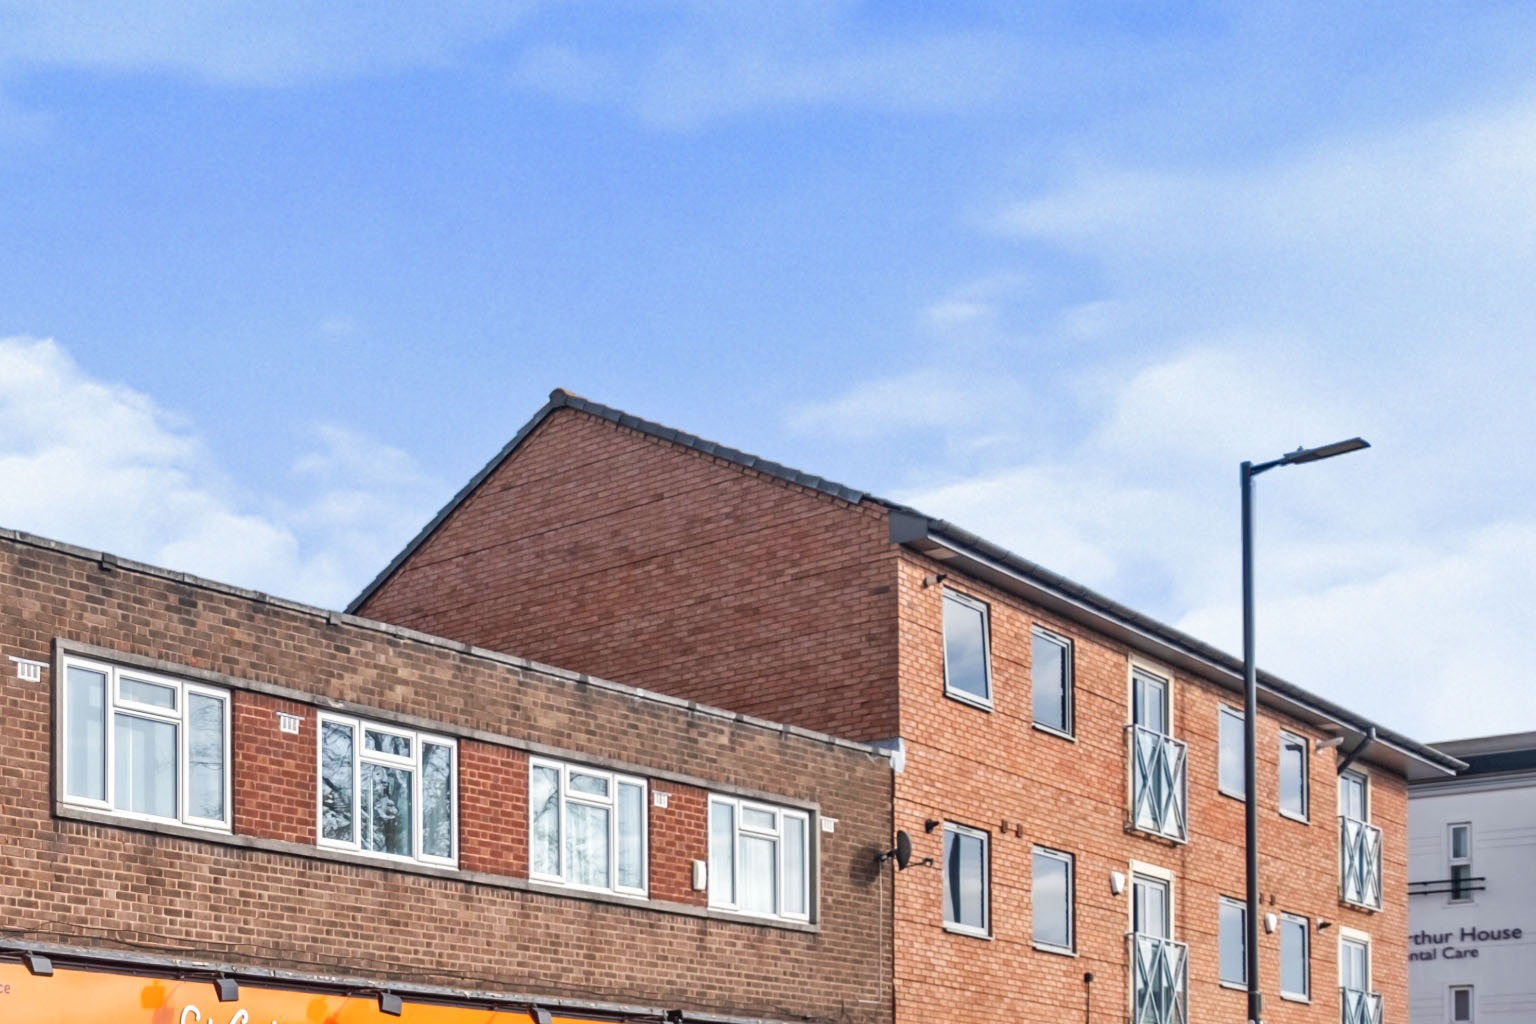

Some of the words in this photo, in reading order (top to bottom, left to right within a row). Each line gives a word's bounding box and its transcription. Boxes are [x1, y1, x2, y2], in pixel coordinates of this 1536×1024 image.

[1408, 930, 1453, 945] thur
[1460, 926, 1523, 942] House
[1408, 948, 1437, 961] ntal
[1442, 946, 1479, 960] Care
